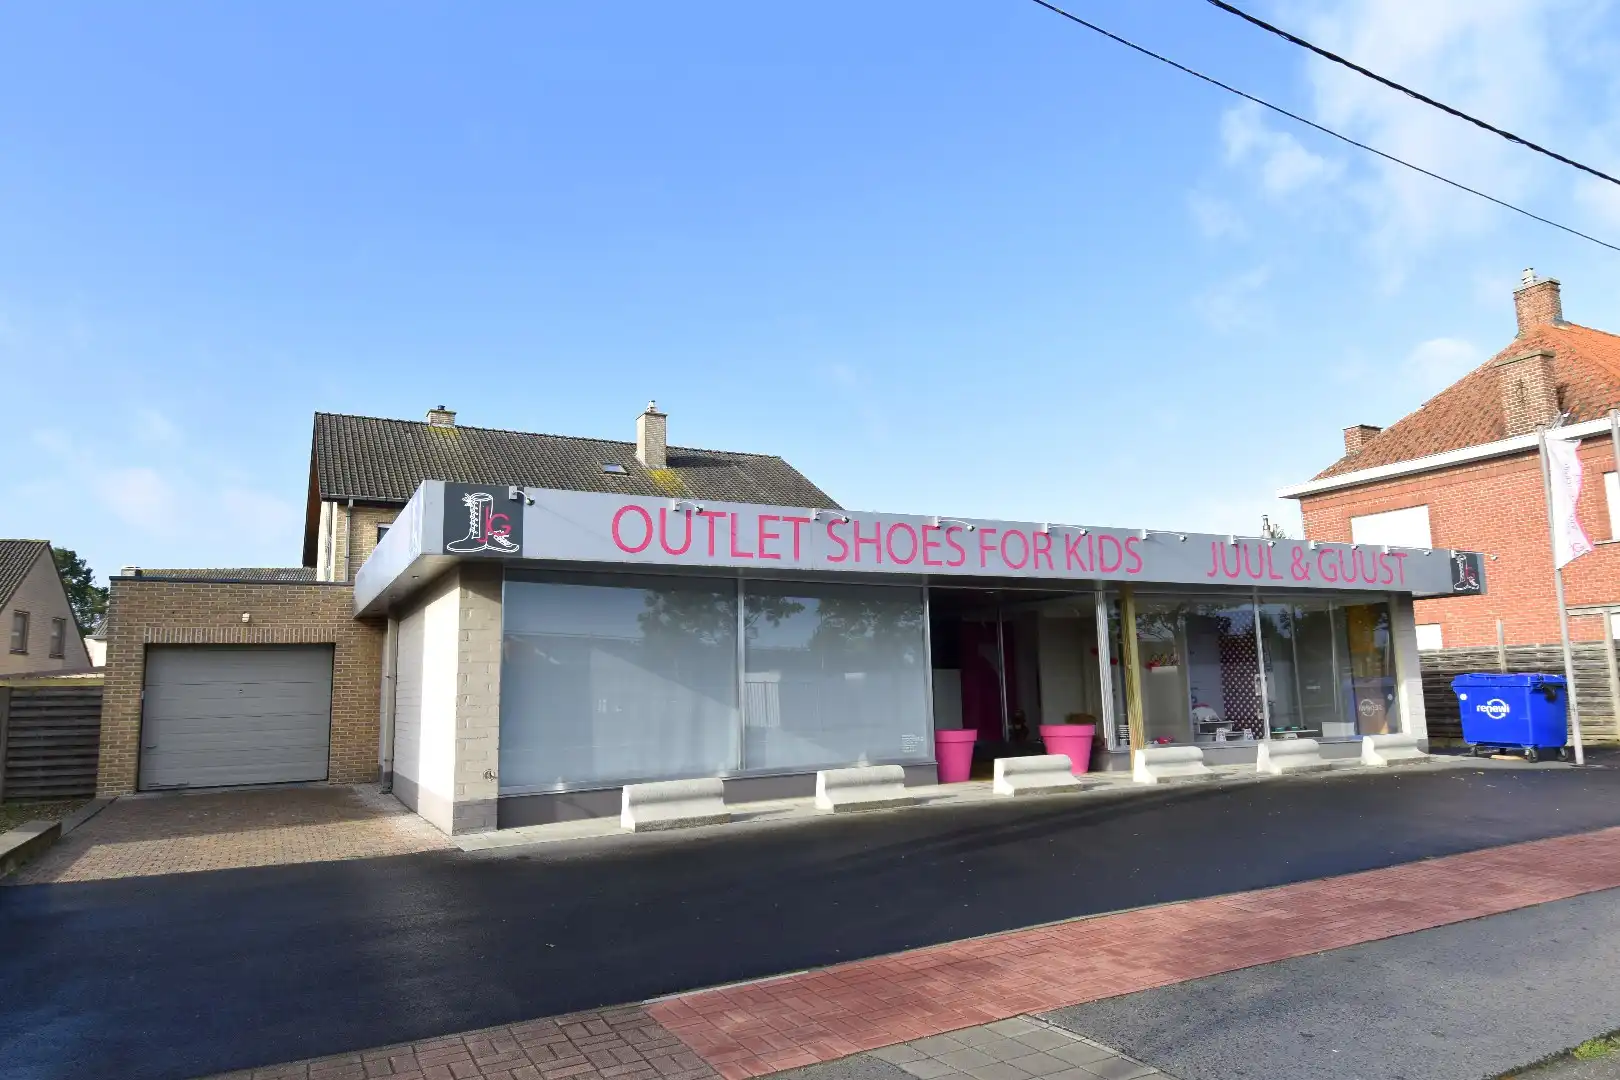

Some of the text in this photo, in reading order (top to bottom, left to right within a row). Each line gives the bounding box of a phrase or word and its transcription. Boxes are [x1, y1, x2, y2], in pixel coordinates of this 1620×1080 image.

[612, 504, 1143, 574] OUTLET SHOES FOR KIDS
[1207, 542, 1408, 585] JUUL & GUUST
[1476, 702, 1511, 714] renewi
